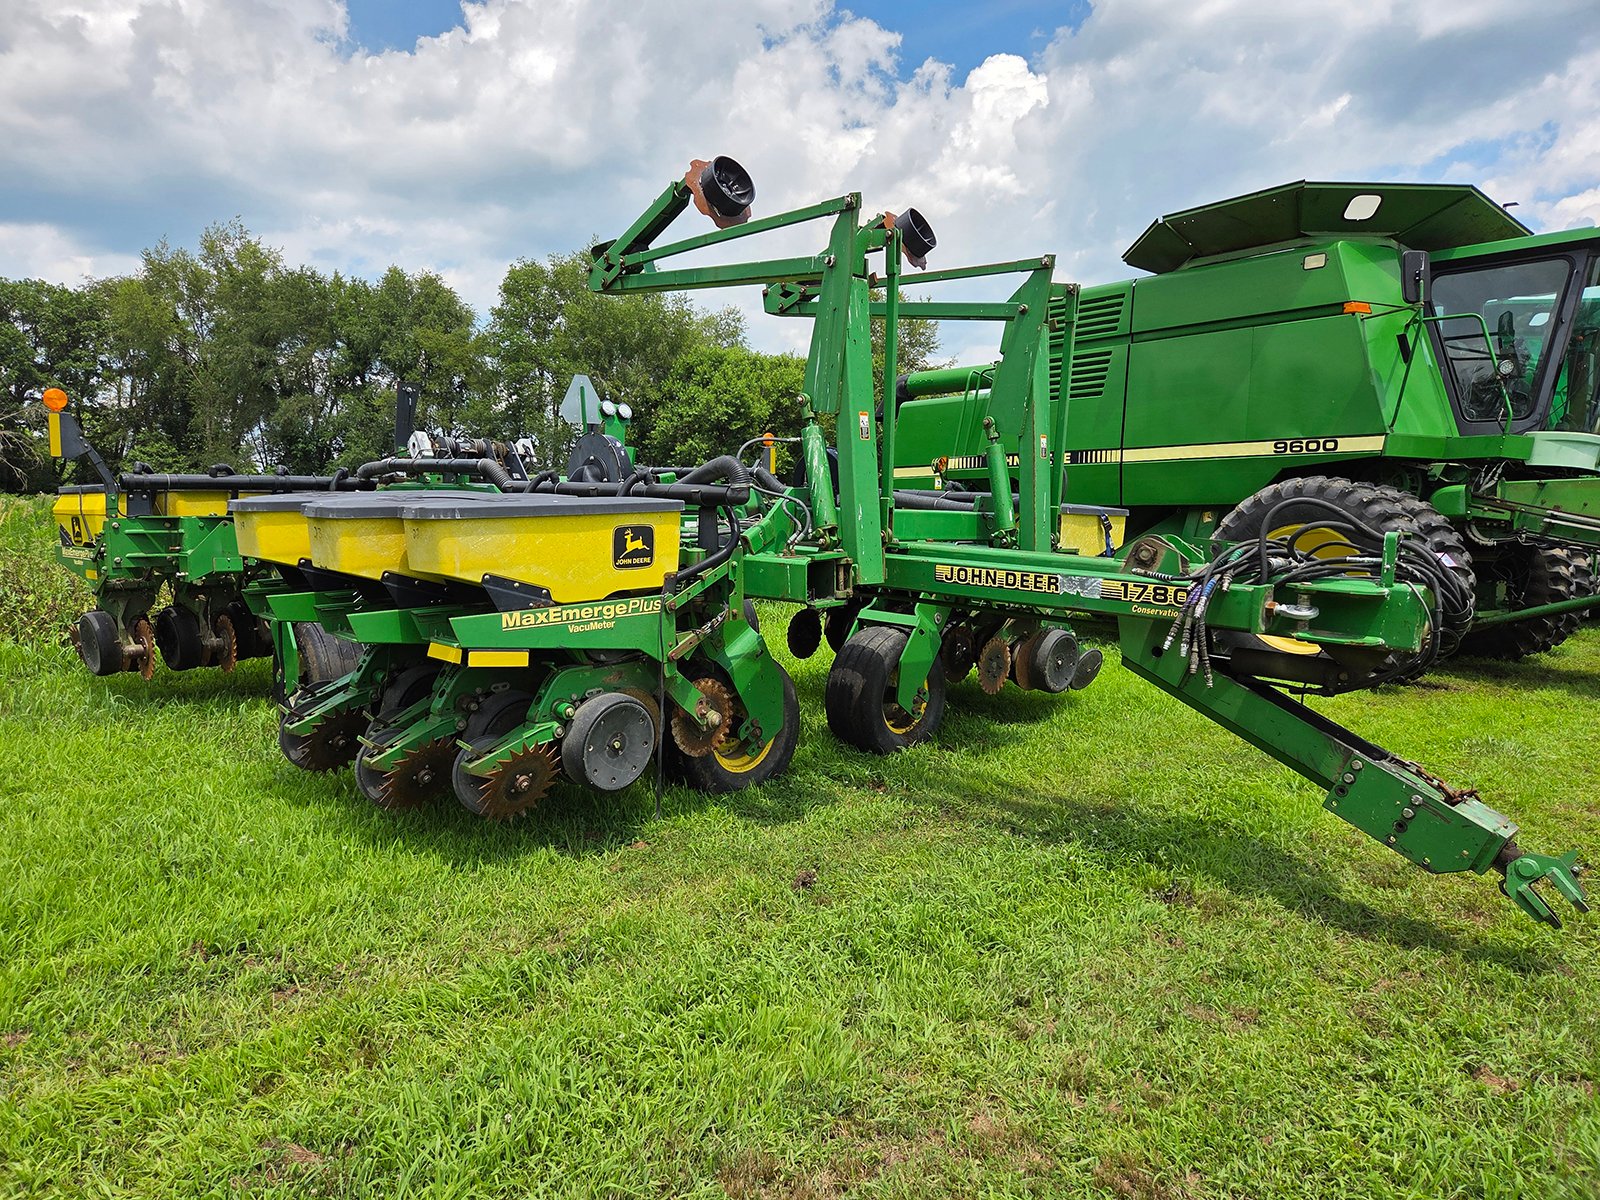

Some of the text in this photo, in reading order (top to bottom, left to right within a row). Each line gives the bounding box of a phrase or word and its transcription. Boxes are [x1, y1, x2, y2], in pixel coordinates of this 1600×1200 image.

[1273, 439, 1339, 454] 9600
[615, 556, 652, 566] JOHN DEERE
[944, 566, 1060, 593] JOHN DEER
[1120, 582, 1188, 607] 1780
[501, 599, 662, 629] MaxEmergePlus
[1131, 604, 1180, 618] Conservatio
[567, 619, 616, 634] VacuMeter
